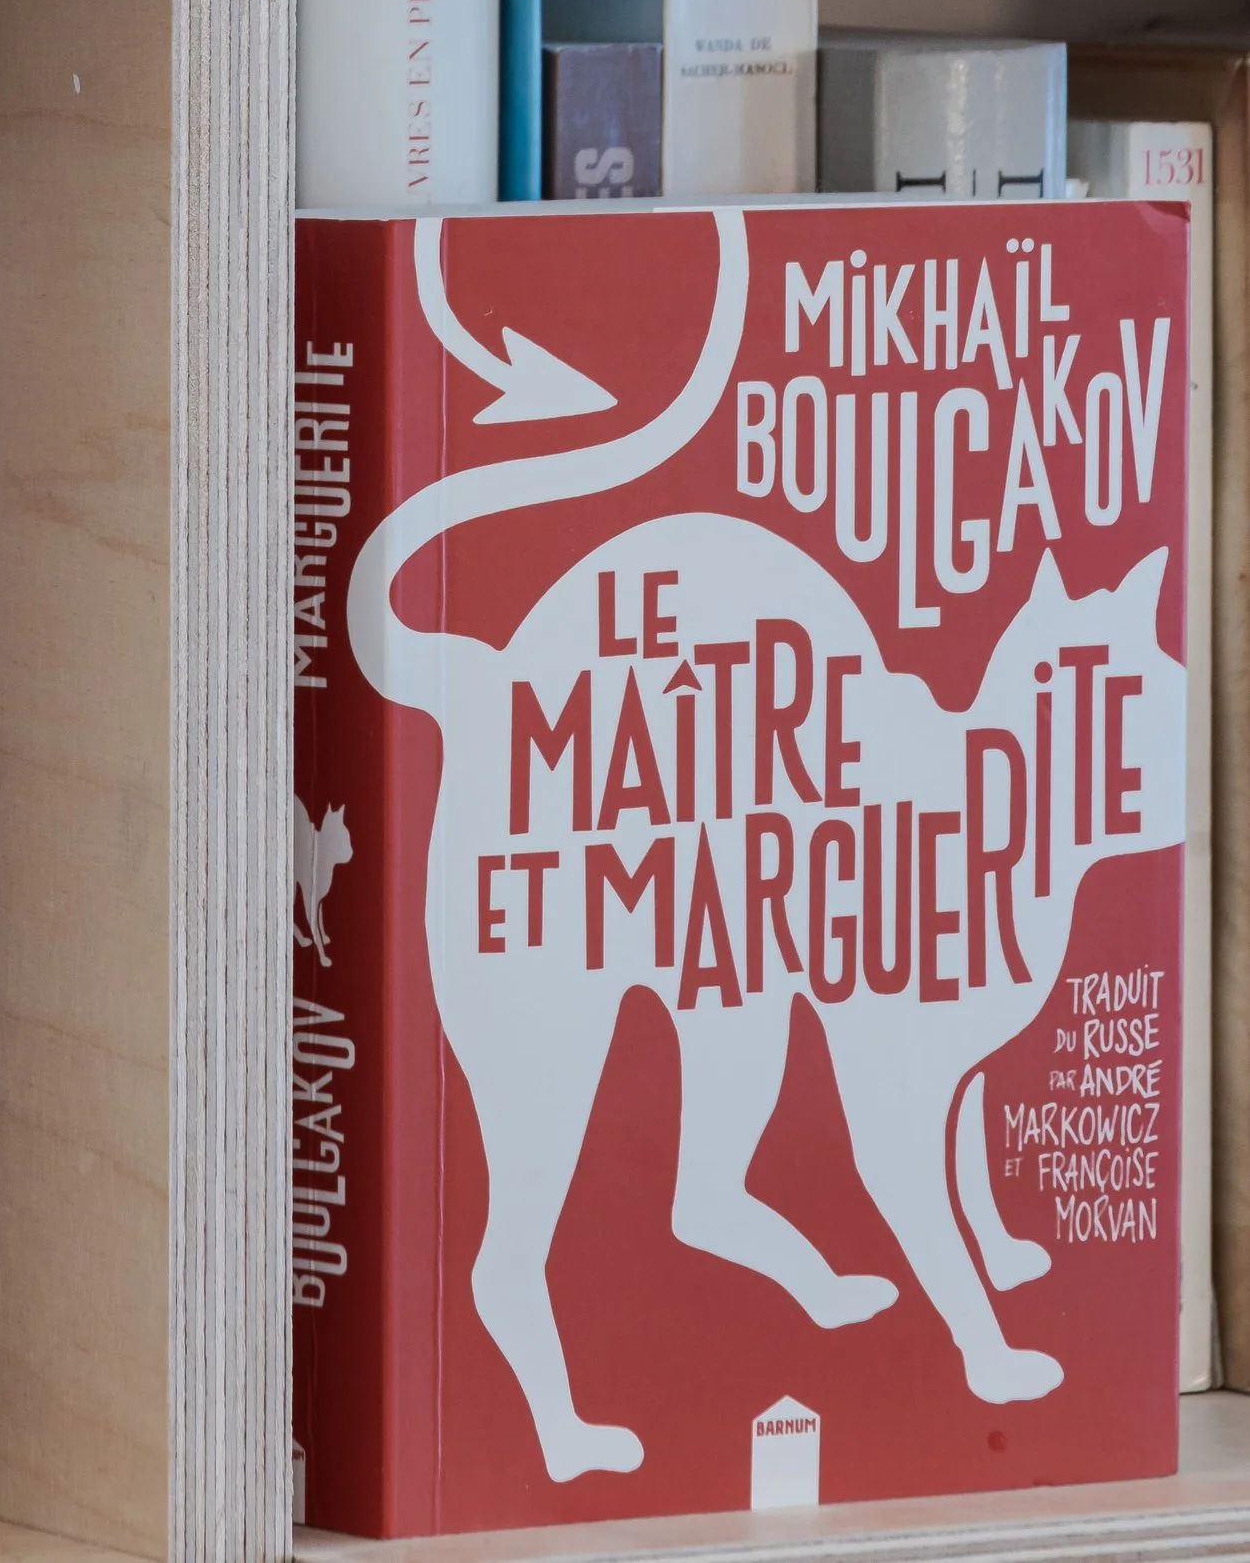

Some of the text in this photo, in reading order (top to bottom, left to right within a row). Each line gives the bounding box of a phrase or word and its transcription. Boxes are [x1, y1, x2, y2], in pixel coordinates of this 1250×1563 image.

[408, 39, 432, 86] EN
[737, 318, 1171, 629] BOULGAKOV
[598, 570, 679, 659] LE
[509, 618, 862, 835] MAÎTRE
[478, 644, 1143, 1011] ET MARGUERITE
[1066, 964, 1165, 1015] TRADUIT
[1053, 1013, 1160, 1060] DU RUSSE
[1049, 1059, 1162, 1099] PAR ANDRÉ
[1004, 1102, 1160, 1152] MARKOWICZ
[1004, 1146, 1159, 1193] ET FRANÇOISE
[1054, 1194, 1157, 1243] MORVAN
[756, 1418, 816, 1436] BARNUM
